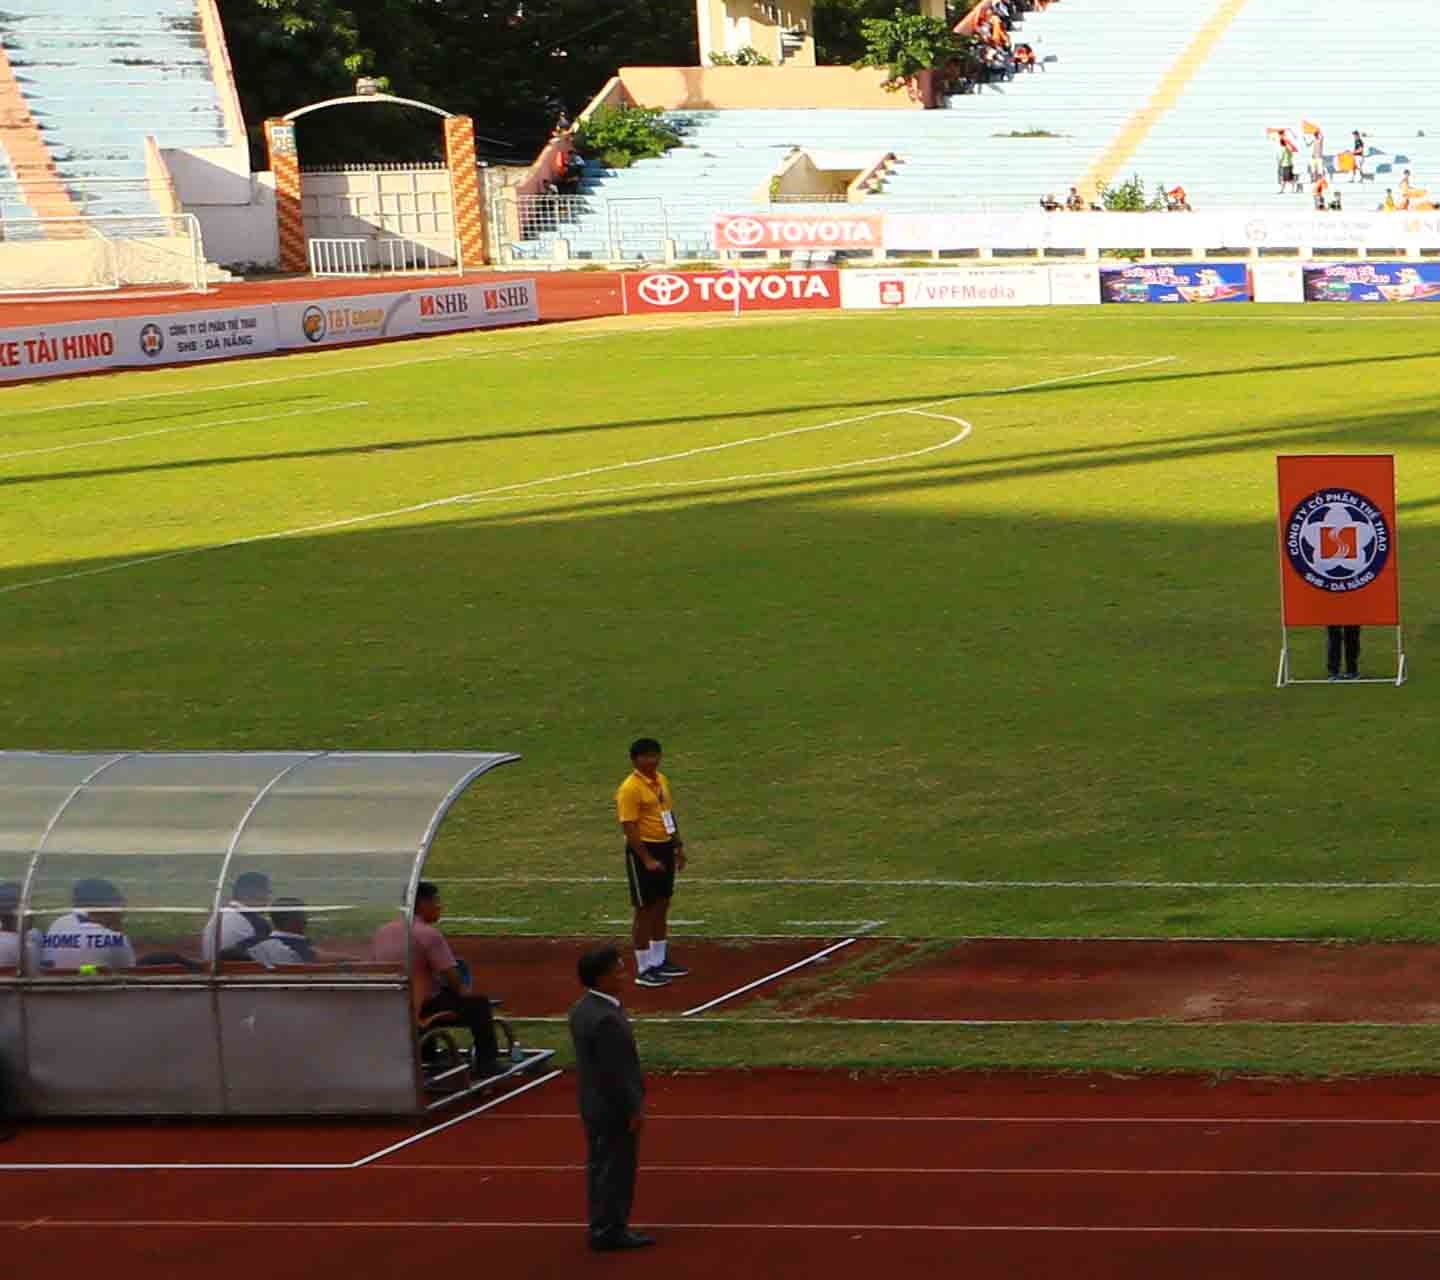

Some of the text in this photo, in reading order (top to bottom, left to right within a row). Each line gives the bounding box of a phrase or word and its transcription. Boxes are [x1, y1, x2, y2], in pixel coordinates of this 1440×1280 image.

[768, 221, 873, 241] TOYOTA
[497, 287, 529, 310] SHB
[693, 275, 830, 301] TOYOTA
[432, 293, 468, 315] SHB
[62, 332, 114, 361] HINO
[42, 933, 124, 948] HOME TEAM
